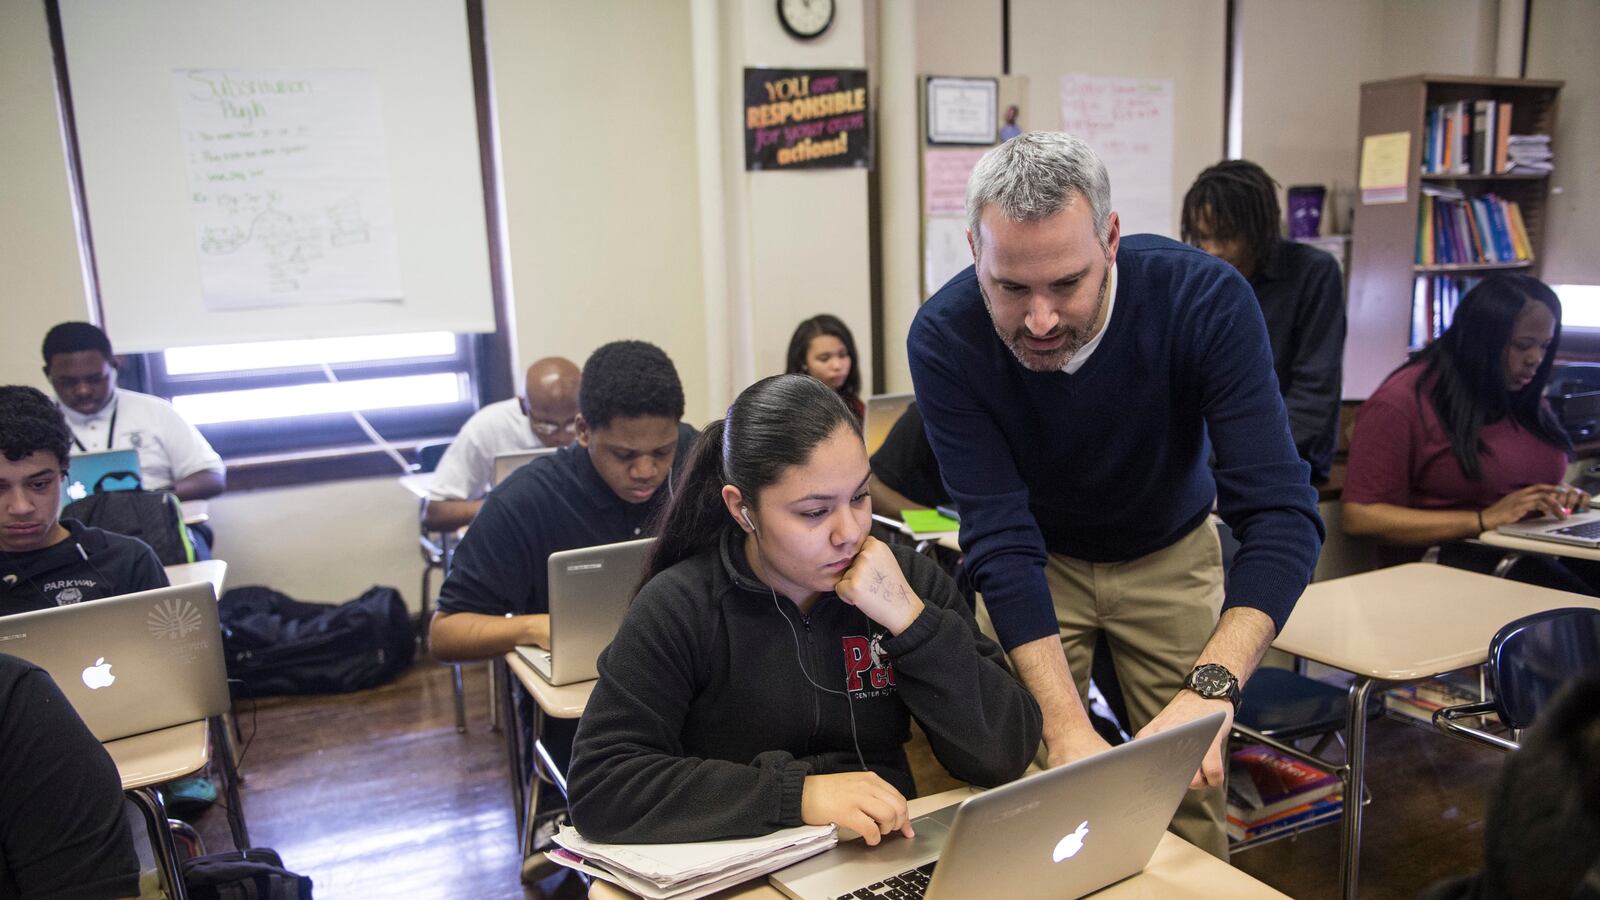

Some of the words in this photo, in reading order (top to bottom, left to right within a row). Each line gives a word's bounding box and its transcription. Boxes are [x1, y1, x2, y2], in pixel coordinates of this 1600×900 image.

[765, 76, 809, 101] YOU
[811, 77, 839, 92] are
[747, 88, 865, 128] RESPONSIBLE
[755, 129, 779, 153] for
[783, 120, 824, 147] your
[827, 113, 864, 132] own
[777, 131, 848, 165] actions!
[43, 580, 97, 592] PARKWAY
[854, 690, 880, 699] CENTER
